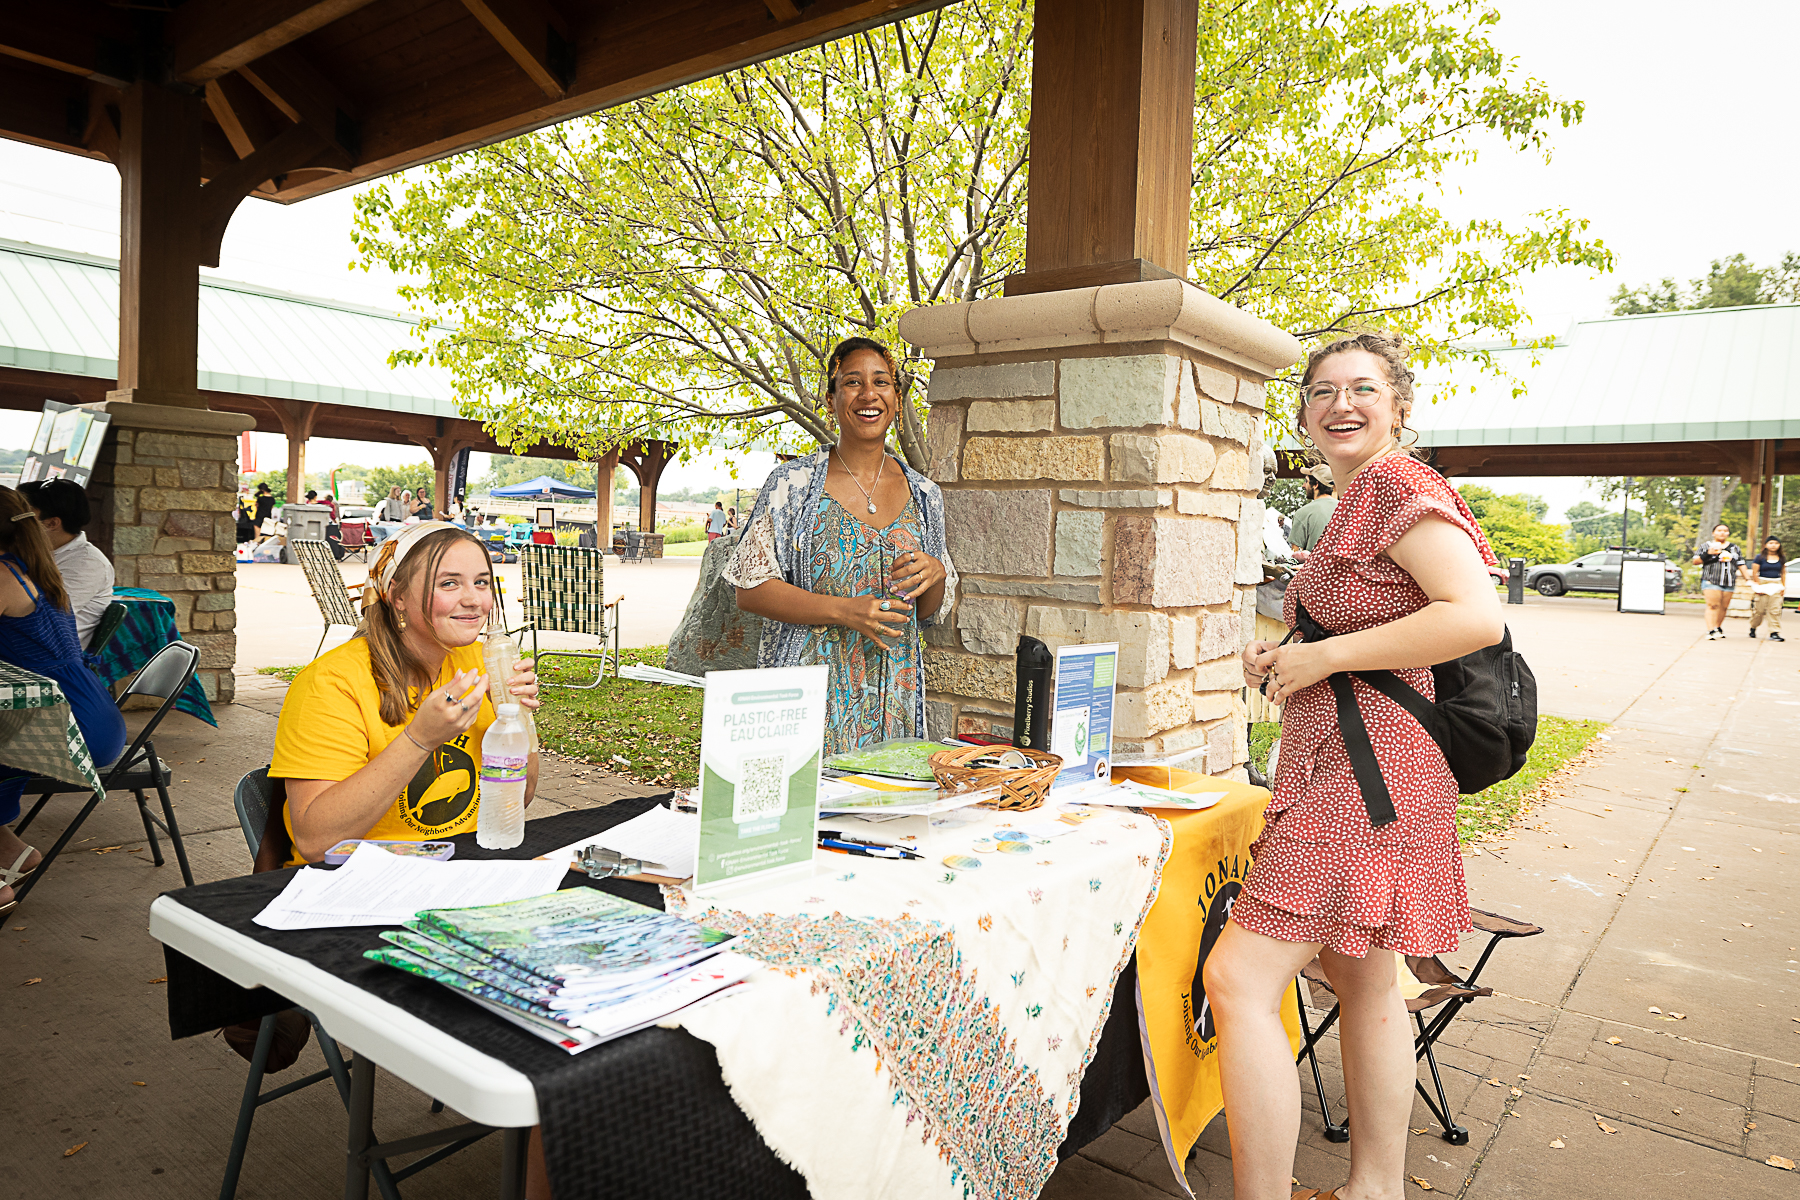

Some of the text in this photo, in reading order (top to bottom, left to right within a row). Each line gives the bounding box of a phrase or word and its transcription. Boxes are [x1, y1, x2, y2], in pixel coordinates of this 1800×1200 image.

[1024, 680, 1034, 735] Pixelberry Studios
[723, 708, 808, 727] PLASTIC-FREE
[730, 723, 800, 742] EAU CLAIRE
[405, 817, 416, 828] Our
[414, 825, 453, 836] Neighbors
[1181, 993, 1201, 1058] Joining Our
